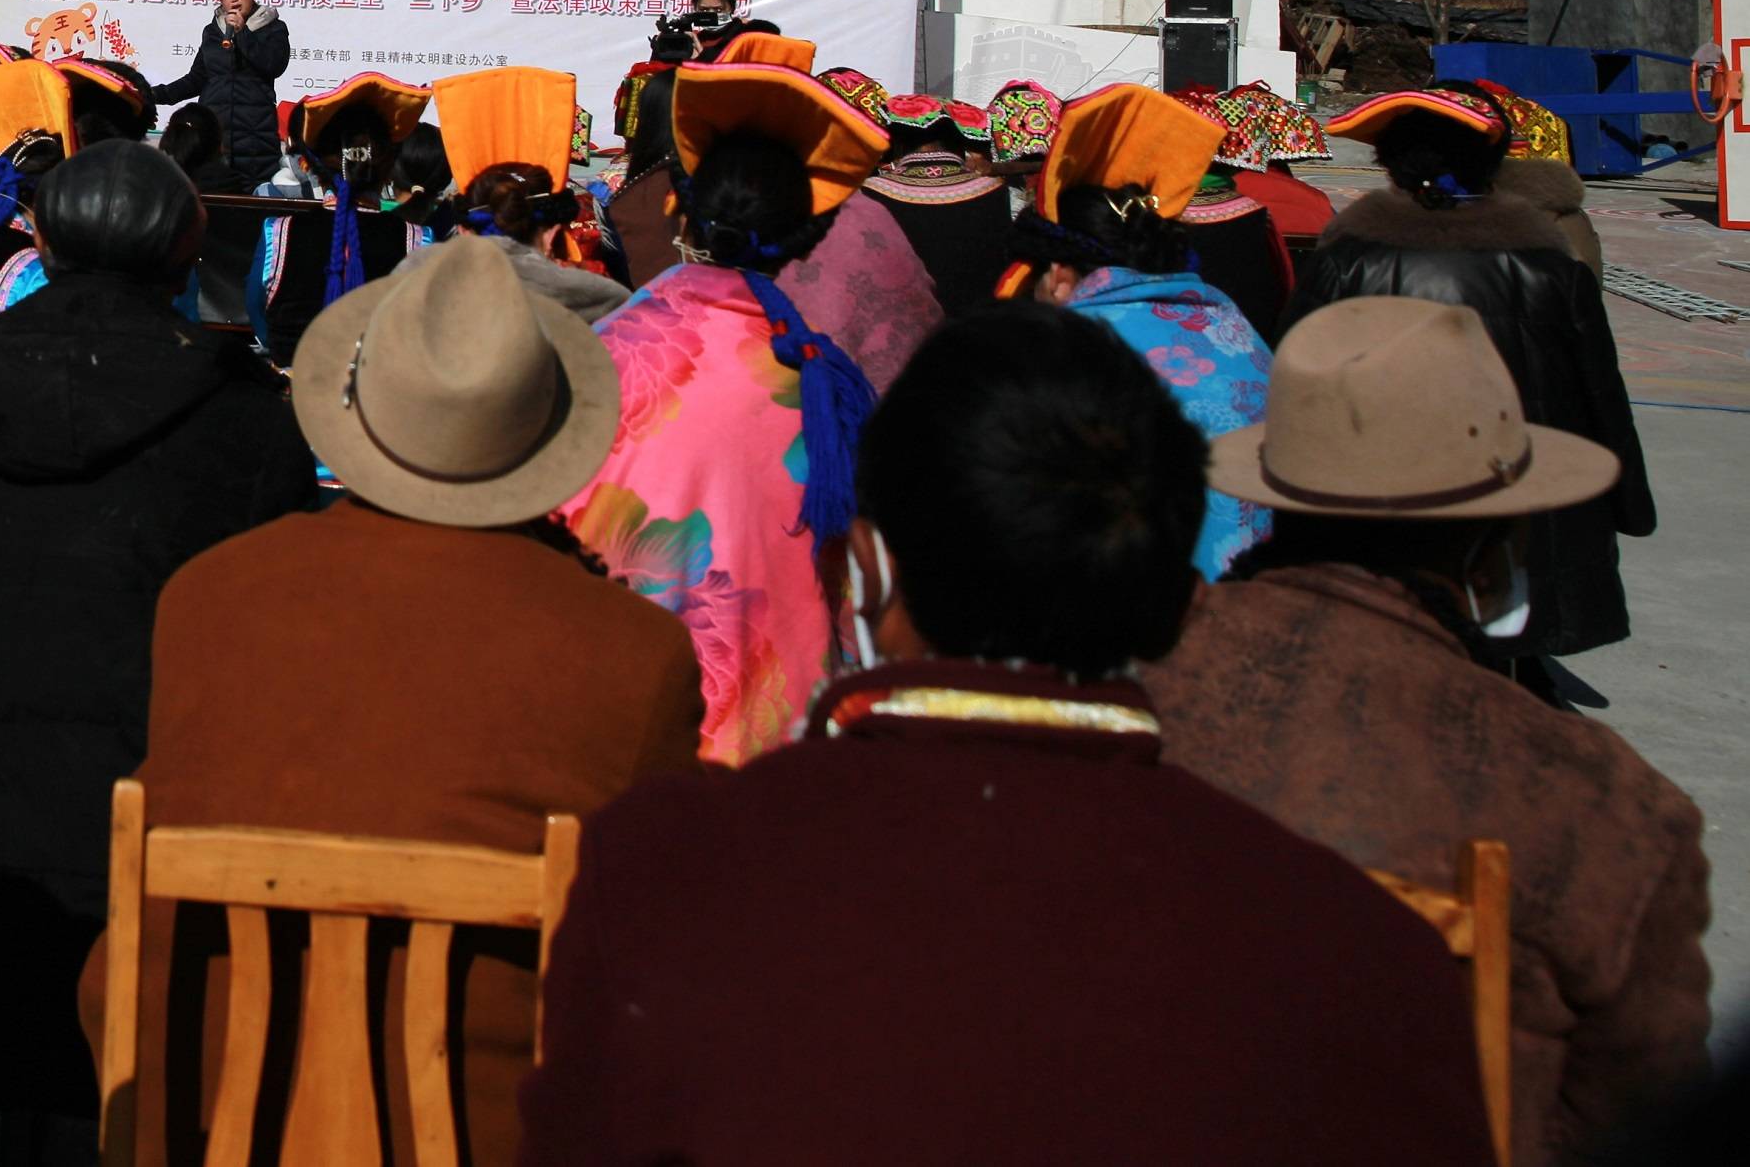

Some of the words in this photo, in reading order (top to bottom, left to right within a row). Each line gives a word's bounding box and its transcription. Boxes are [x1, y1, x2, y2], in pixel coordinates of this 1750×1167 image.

[361, 51, 509, 67] 理县精神文明建设办公室
